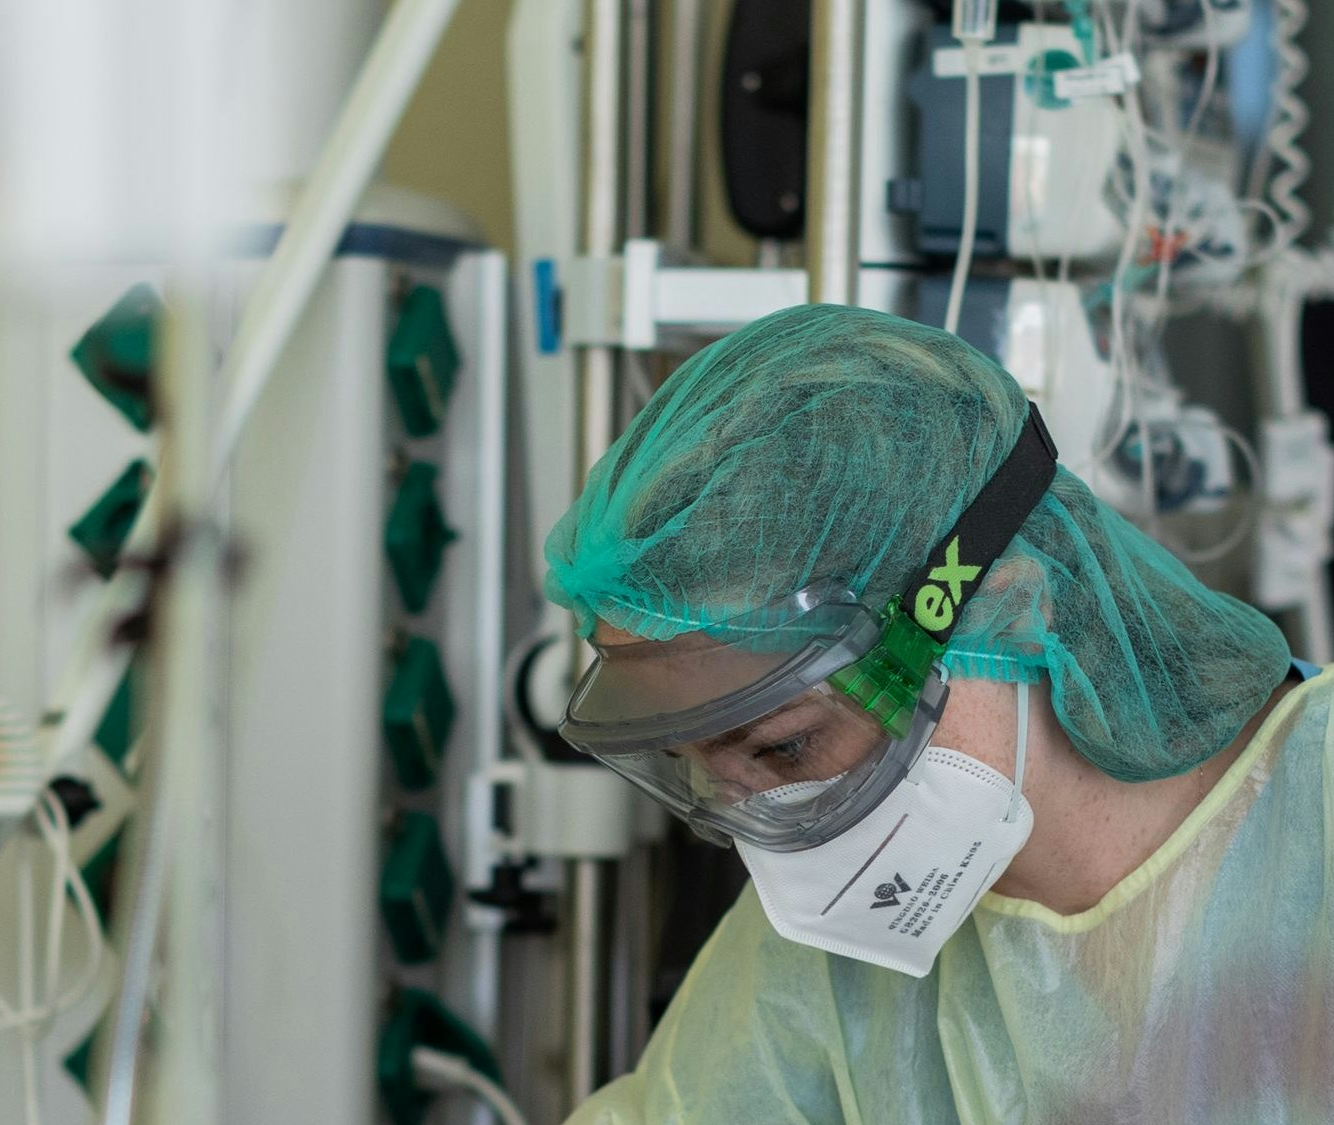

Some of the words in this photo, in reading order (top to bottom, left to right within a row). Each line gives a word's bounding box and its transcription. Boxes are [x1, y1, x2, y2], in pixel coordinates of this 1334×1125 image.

[888, 895, 919, 931] QINGDAO
[916, 867, 939, 894] WEIDA
[899, 873, 949, 934] GB2626-2006
[911, 915, 934, 938] Made
[931, 903, 943, 913] in
[940, 871, 963, 900] China
[960, 841, 982, 868] KN95
